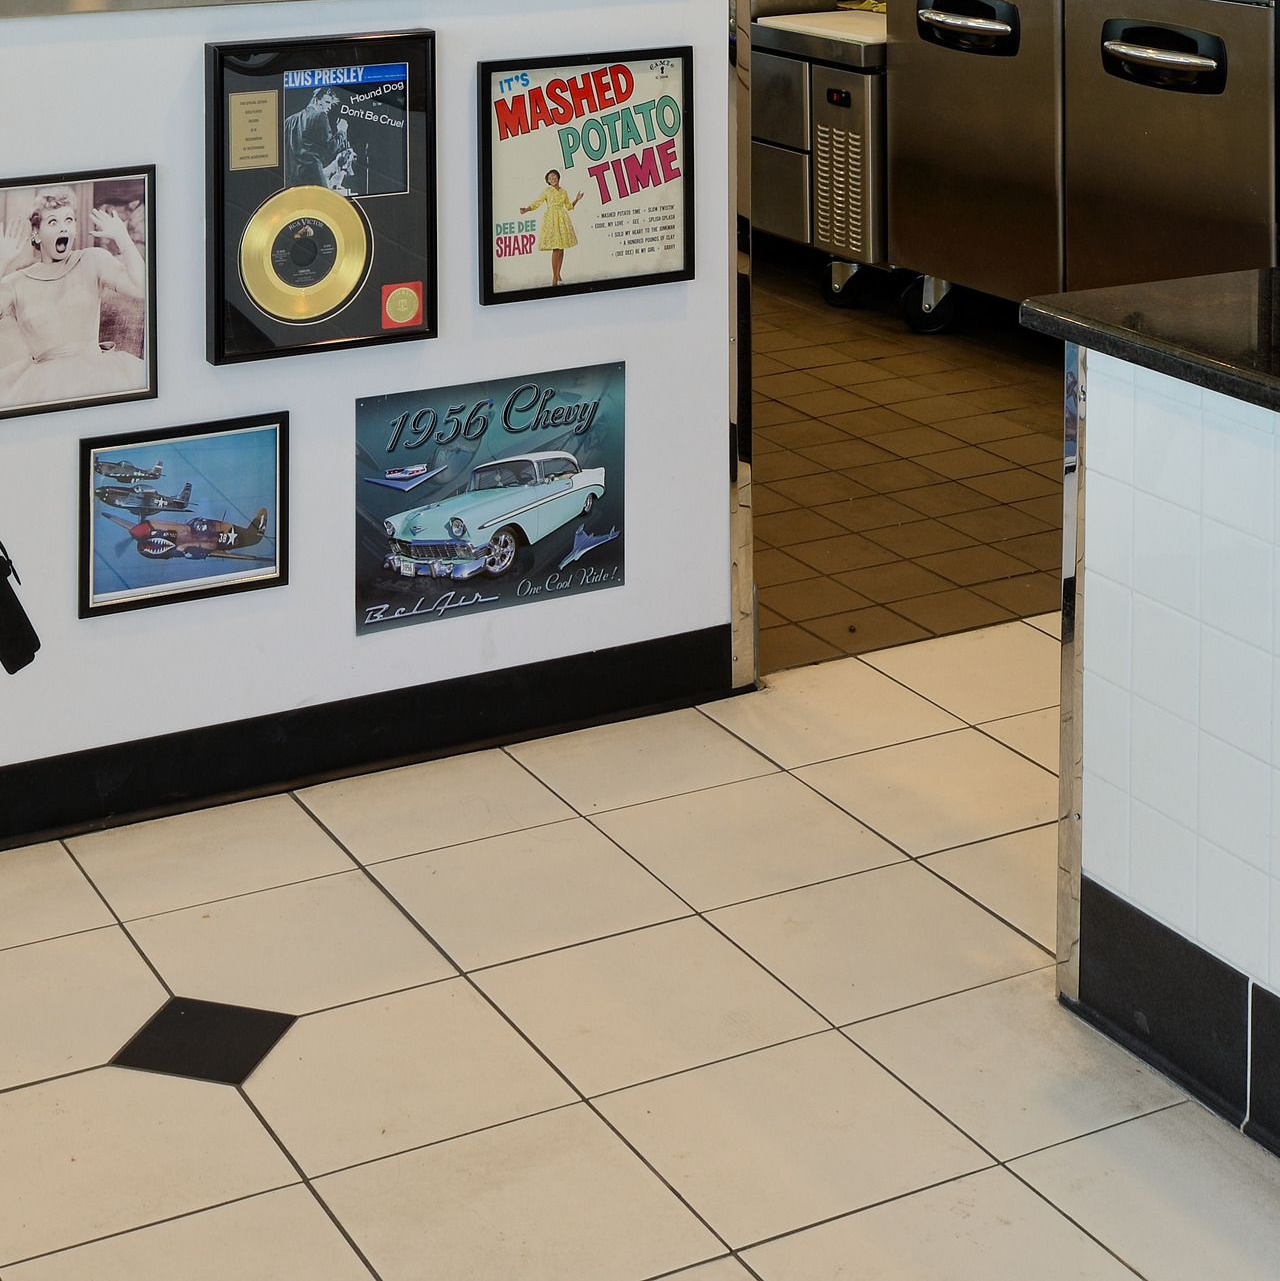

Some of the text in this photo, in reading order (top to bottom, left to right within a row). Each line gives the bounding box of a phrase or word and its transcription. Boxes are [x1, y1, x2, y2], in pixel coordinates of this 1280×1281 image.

[284, 67, 364, 87] ELVIS PRESLEY
[499, 72, 530, 94] IT'S
[350, 81, 405, 105] Hound Dog
[494, 63, 635, 141] MASHED
[340, 104, 405, 128] Don't Be Cruel
[558, 94, 681, 169] POTATO
[588, 138, 682, 206] TIME
[288, 218, 324, 230] RCA VICTOR
[495, 219, 536, 236] DEE DEE
[495, 233, 536, 258] SHARP
[386, 382, 600, 452] 1956 Chevy
[516, 566, 618, 599] One Cool Ride!
